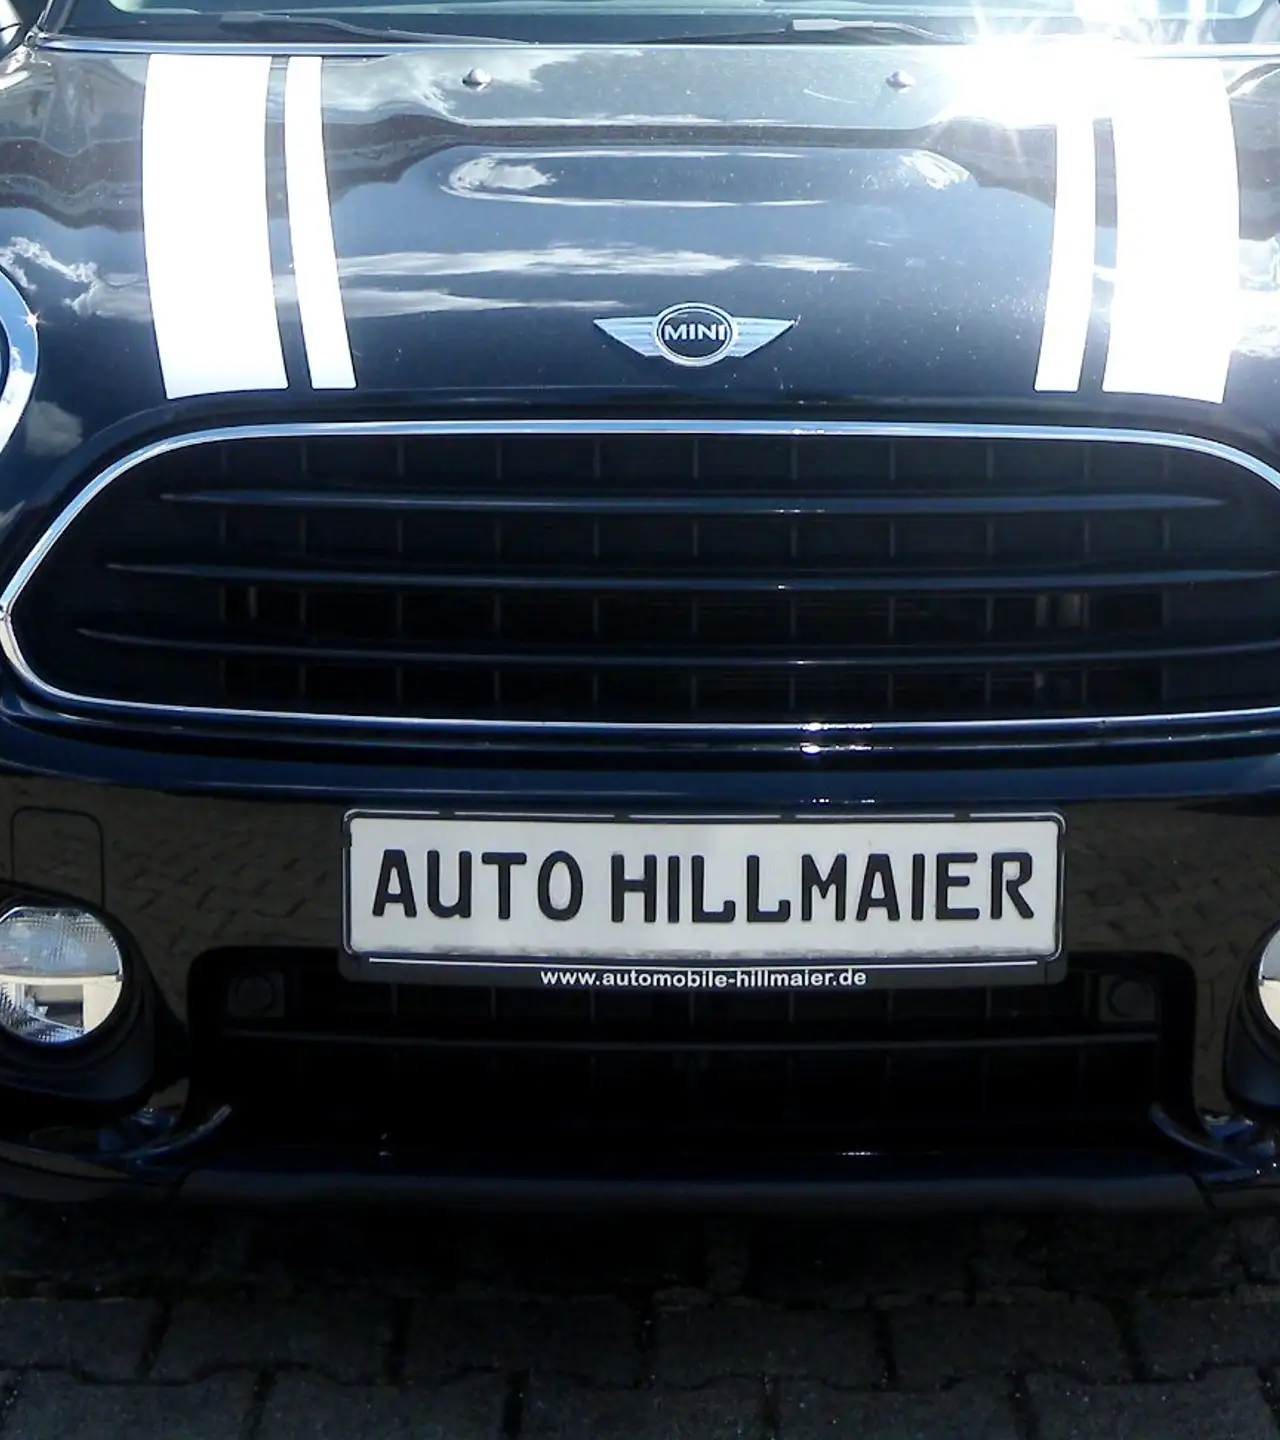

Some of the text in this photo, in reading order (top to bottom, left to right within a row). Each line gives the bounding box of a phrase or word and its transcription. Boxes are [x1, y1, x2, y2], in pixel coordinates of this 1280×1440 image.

[664, 323, 726, 341] MINI
[372, 849, 1035, 924] AUTO HILLMAIER
[540, 968, 867, 988] www.automobile-hillmaier.de
